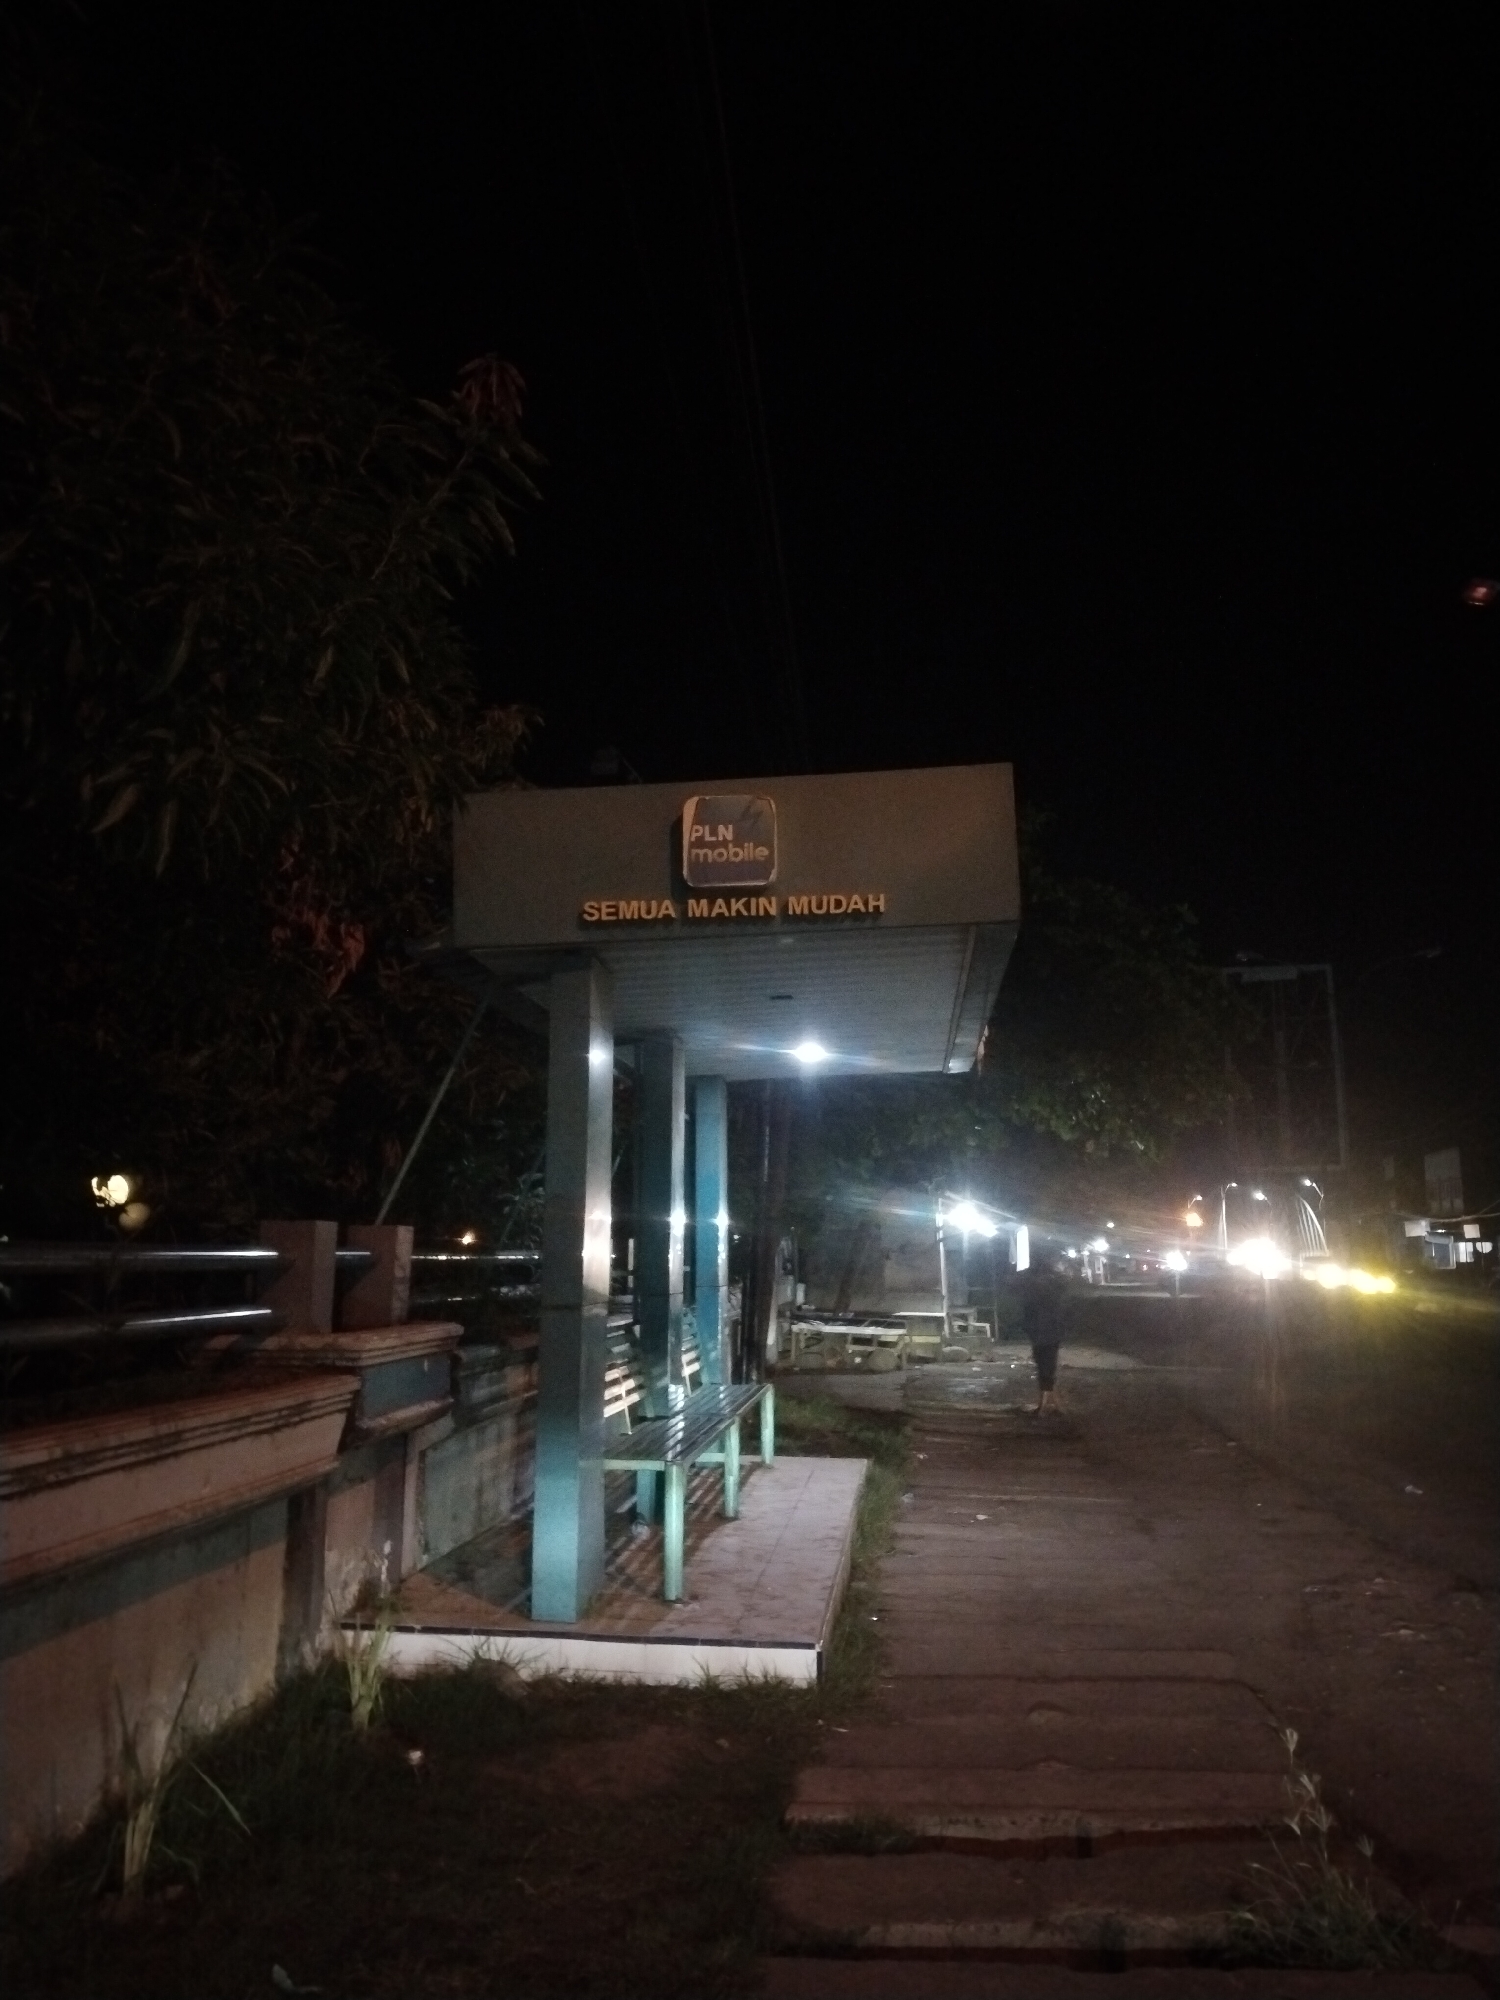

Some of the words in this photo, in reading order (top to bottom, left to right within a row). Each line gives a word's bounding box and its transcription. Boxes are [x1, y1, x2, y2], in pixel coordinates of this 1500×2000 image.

[690, 824, 734, 842] PLN
[691, 842, 770, 863] mobile
[583, 899, 676, 921] SEMUA
[687, 896, 777, 918] MAKIN
[787, 893, 886, 916] MUDAH
